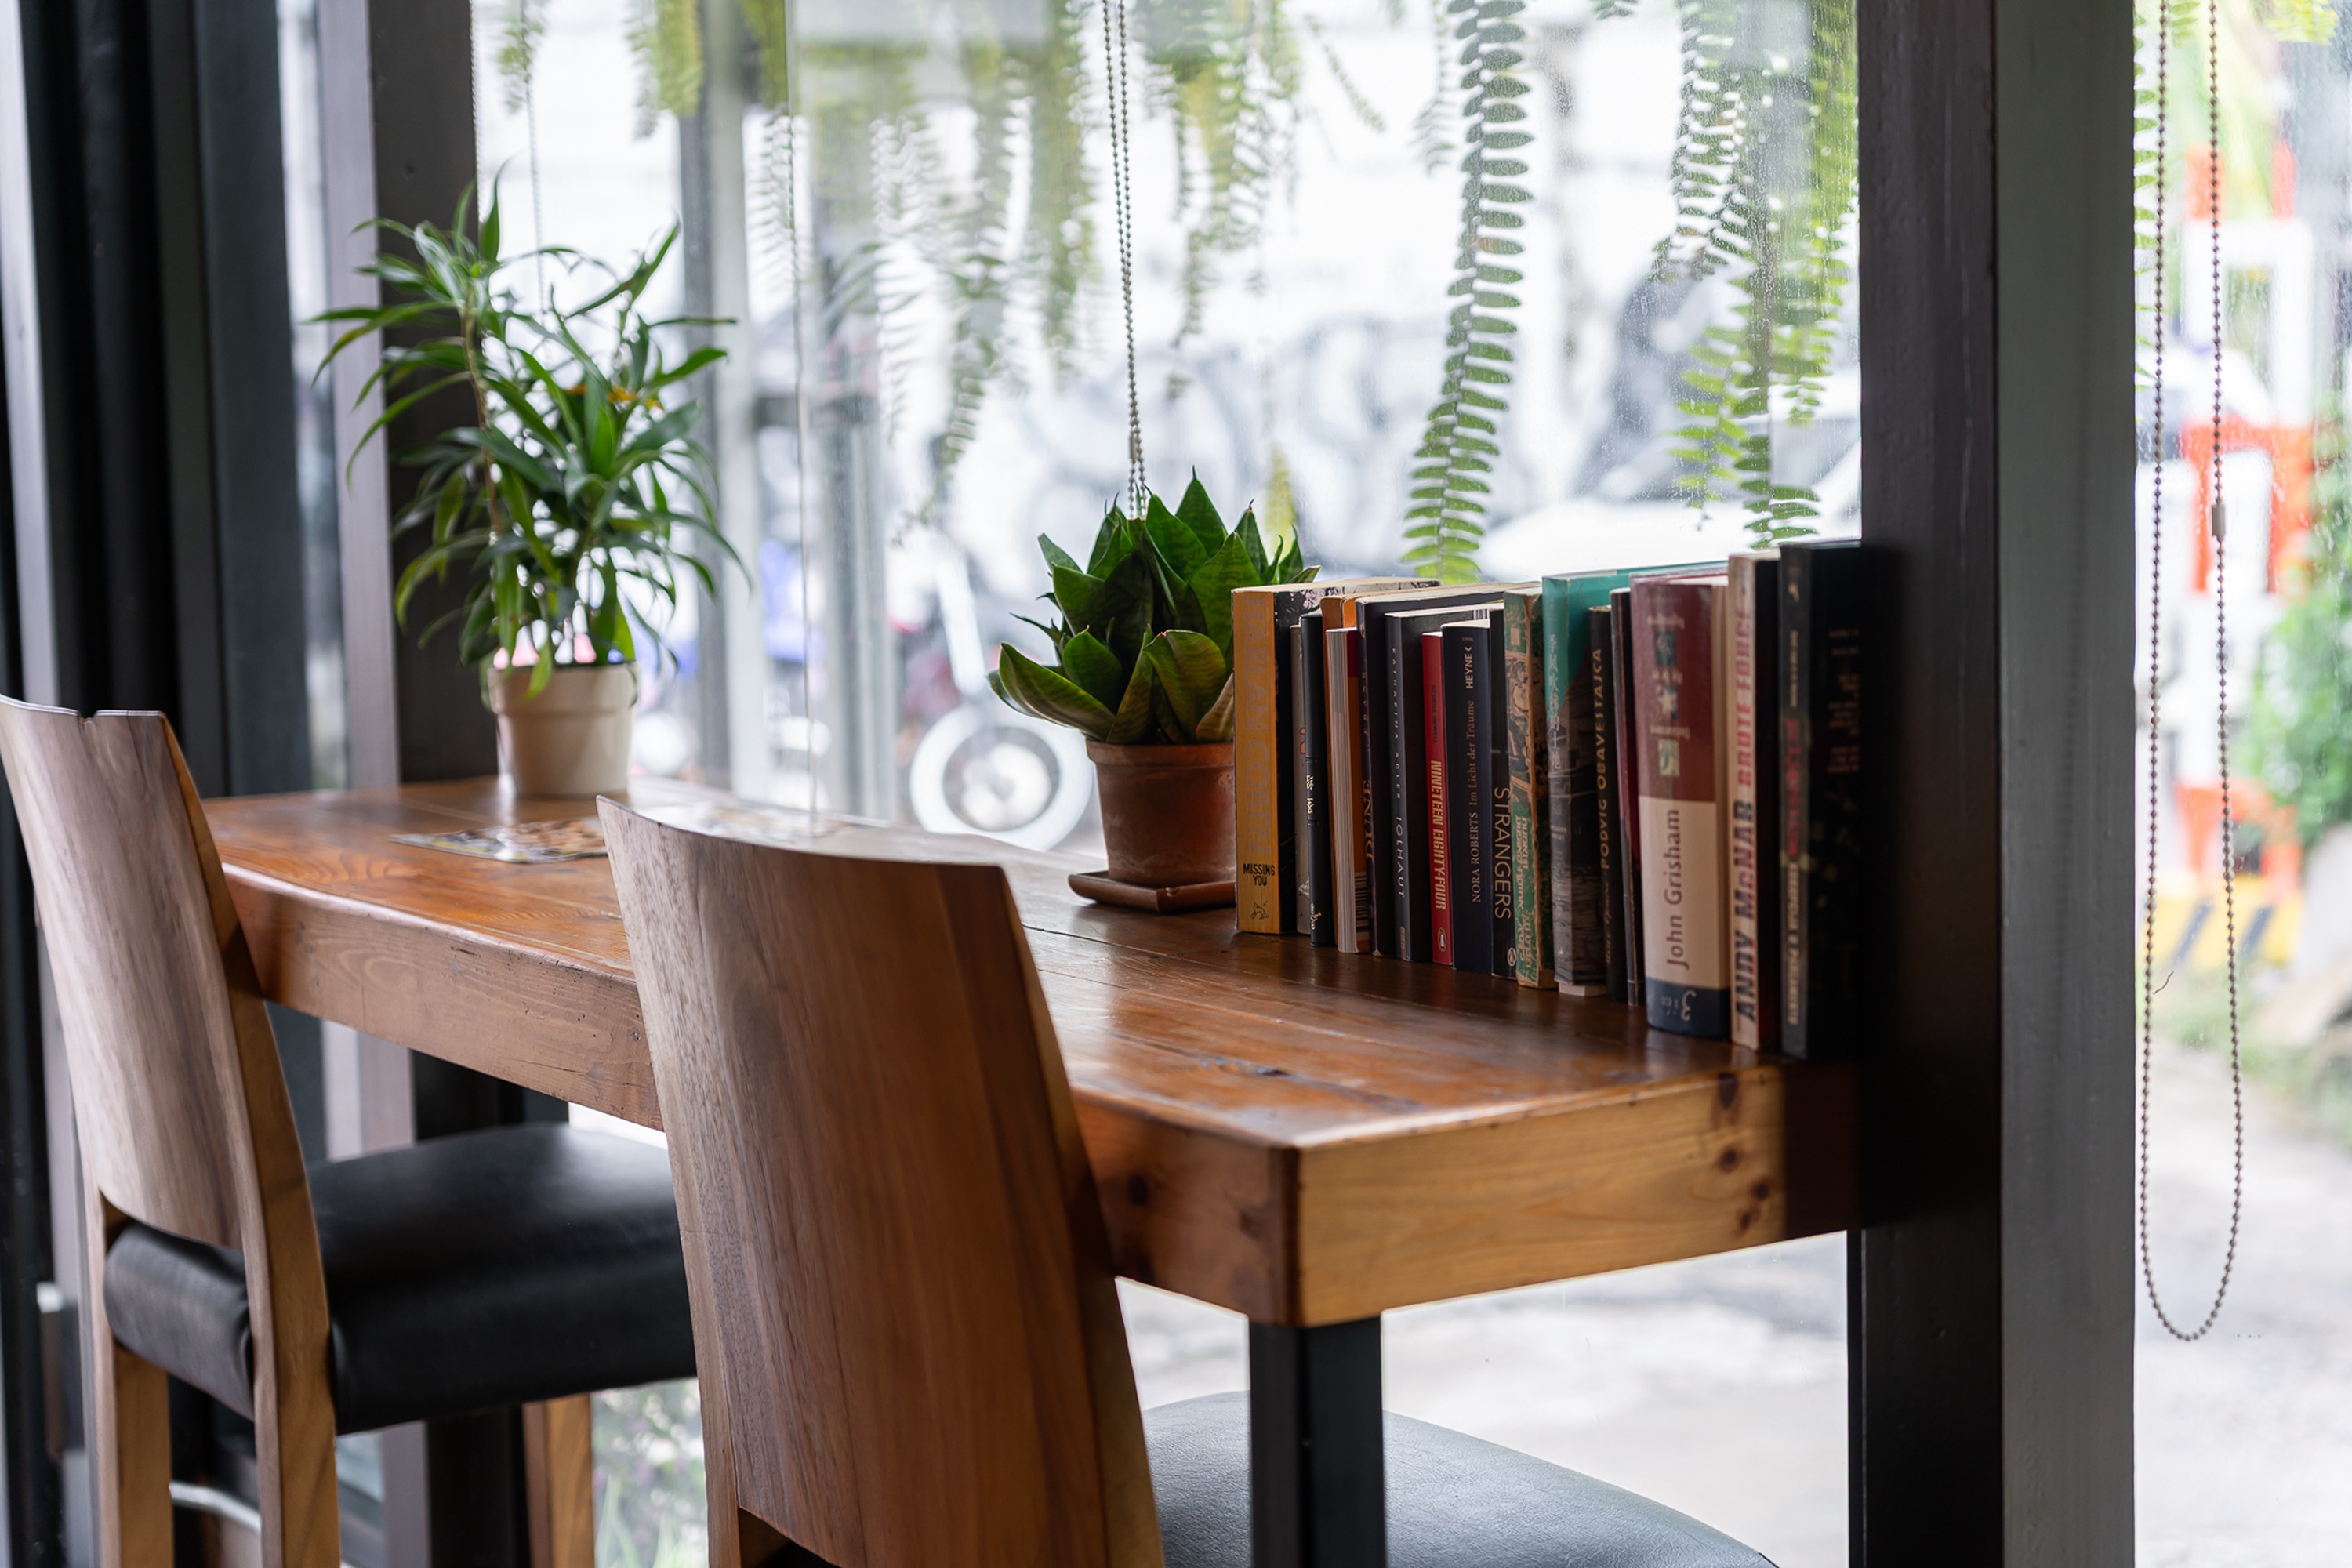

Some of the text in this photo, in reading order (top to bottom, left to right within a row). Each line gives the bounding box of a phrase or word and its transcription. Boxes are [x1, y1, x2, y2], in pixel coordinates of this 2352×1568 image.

[1391, 648, 1399, 739] KATHARINA
[1465, 653, 1474, 689] HEYNE
[1243, 598, 1270, 854] HARLAN COBEN
[1465, 700, 1477, 806] Im Licht der Träume
[1737, 703, 1751, 786] BRUTE
[1363, 780, 1374, 859] DUNE
[1396, 816, 1406, 898] IGLHAUT
[1430, 760, 1446, 910] NINETEEN EIGHTY-FOUR
[1469, 812, 1481, 902] NORA ROBERTS
[1494, 786, 1512, 919] STRANGERS
[1598, 798, 1610, 869] PODVIG
[1243, 864, 1275, 876] MISSING
[1253, 875, 1268, 886] YOU
[1664, 808, 1690, 971] John Grisham
[1734, 929, 1754, 1023] ANDY
